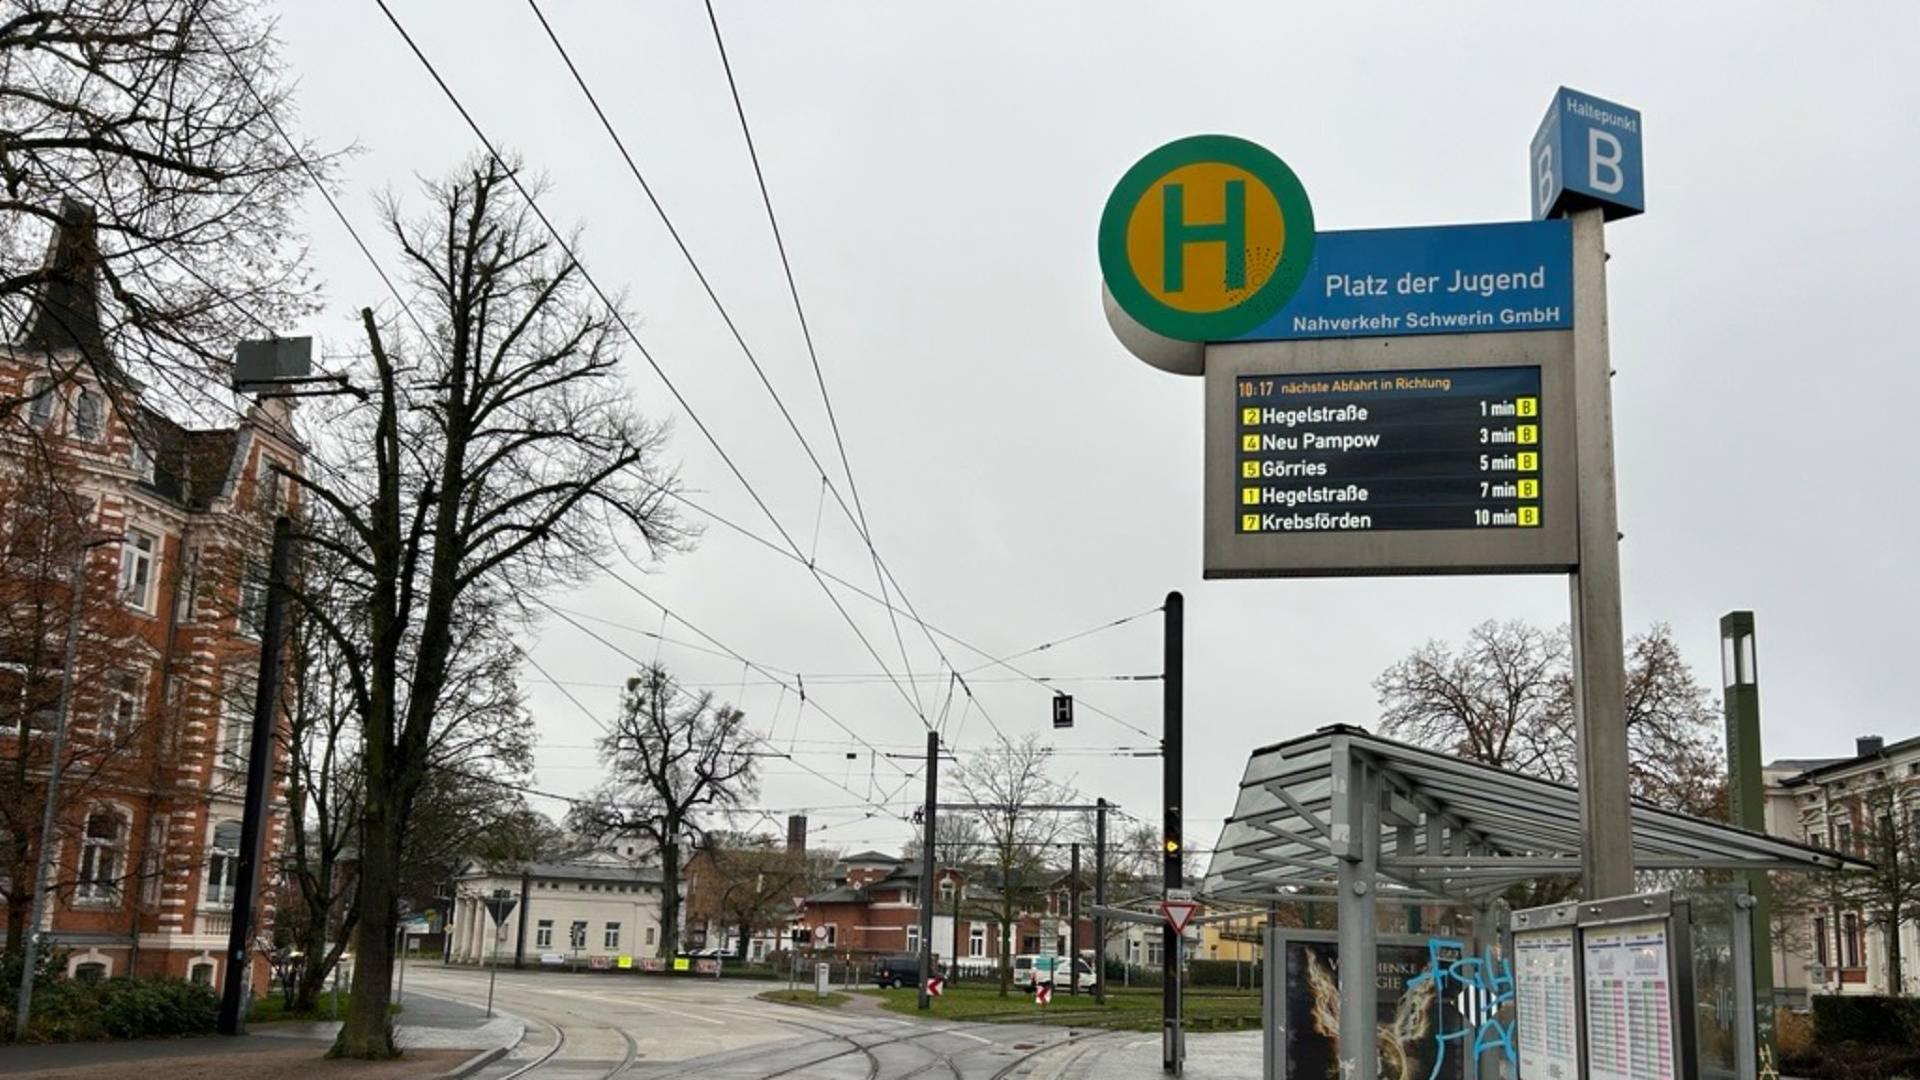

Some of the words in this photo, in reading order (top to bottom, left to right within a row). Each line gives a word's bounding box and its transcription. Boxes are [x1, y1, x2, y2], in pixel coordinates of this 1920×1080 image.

[1566, 97, 1637, 133] Haltepunkt
[1588, 127, 1624, 194] B
[1538, 144, 1553, 216] B
[1163, 180, 1246, 293] H
[1325, 273, 1388, 298] Platz
[1396, 272, 1440, 295] der
[1448, 266, 1546, 297] Jugend
[1293, 314, 1400, 332] Nahverkehr
[1405, 310, 1494, 329] Schwerin
[1500, 307, 1560, 325] GmbH
[1239, 381, 1274, 397] 10:17
[1281, 381, 1329, 395] nächste
[1331, 379, 1378, 393] Abfahrt
[1381, 379, 1393, 391] in
[1395, 377, 1451, 391] Richtung
[1246, 410, 1257, 424] 2
[1262, 404, 1368, 428] Hegelstraße
[1479, 401, 1487, 416] 1
[1491, 400, 1515, 416] min
[1522, 400, 1531, 414] B
[1246, 437, 1257, 450] 4
[1262, 434, 1298, 450] Neu
[1303, 432, 1380, 452] Pampow
[1480, 427, 1489, 443] 3
[1491, 427, 1515, 443] min
[1522, 427, 1532, 442] B
[1247, 463, 1257, 477] 5
[1262, 459, 1327, 477] Görries
[1480, 454, 1489, 470] 5
[1491, 454, 1516, 470] min
[1523, 454, 1532, 468] B
[1262, 485, 1369, 507] Hegelstraße
[1480, 481, 1489, 498] 7
[1491, 481, 1516, 498] min
[1523, 482, 1532, 496] B
[1247, 516, 1257, 529] 7
[1262, 512, 1371, 530] Krebsförden
[1474, 509, 1490, 525] 10
[1492, 508, 1517, 525] min
[1524, 509, 1533, 523] B
[1056, 699, 1070, 720] H
